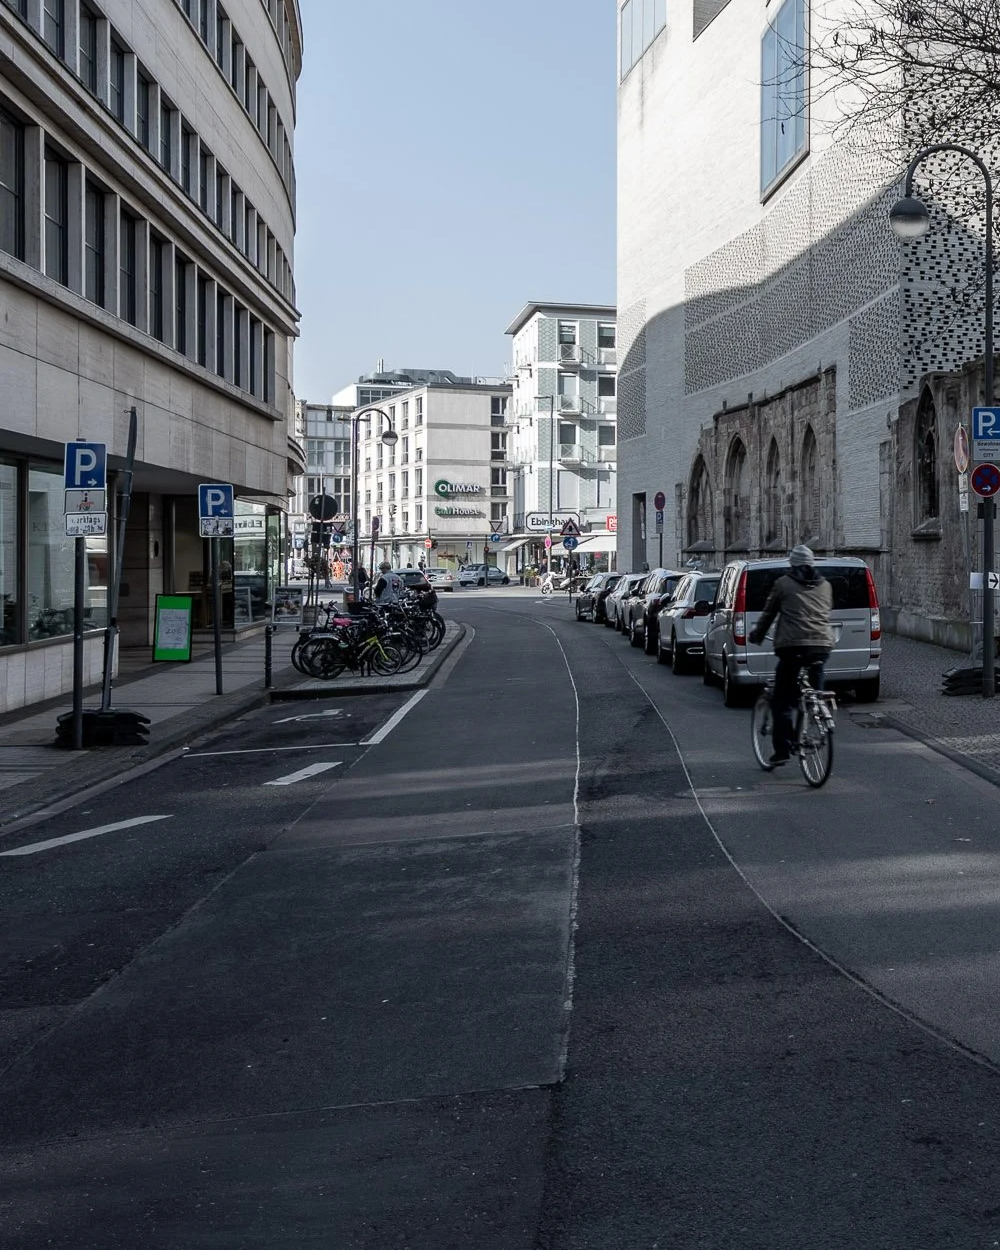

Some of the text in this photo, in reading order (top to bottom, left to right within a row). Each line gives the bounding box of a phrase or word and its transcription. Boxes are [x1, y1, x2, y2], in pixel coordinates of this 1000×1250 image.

[978, 411, 996, 437] P
[75, 448, 97, 486] P
[438, 483, 480, 493] OLIMAR
[206, 489, 226, 516] P
[531, 518, 575, 528] Ebingha
